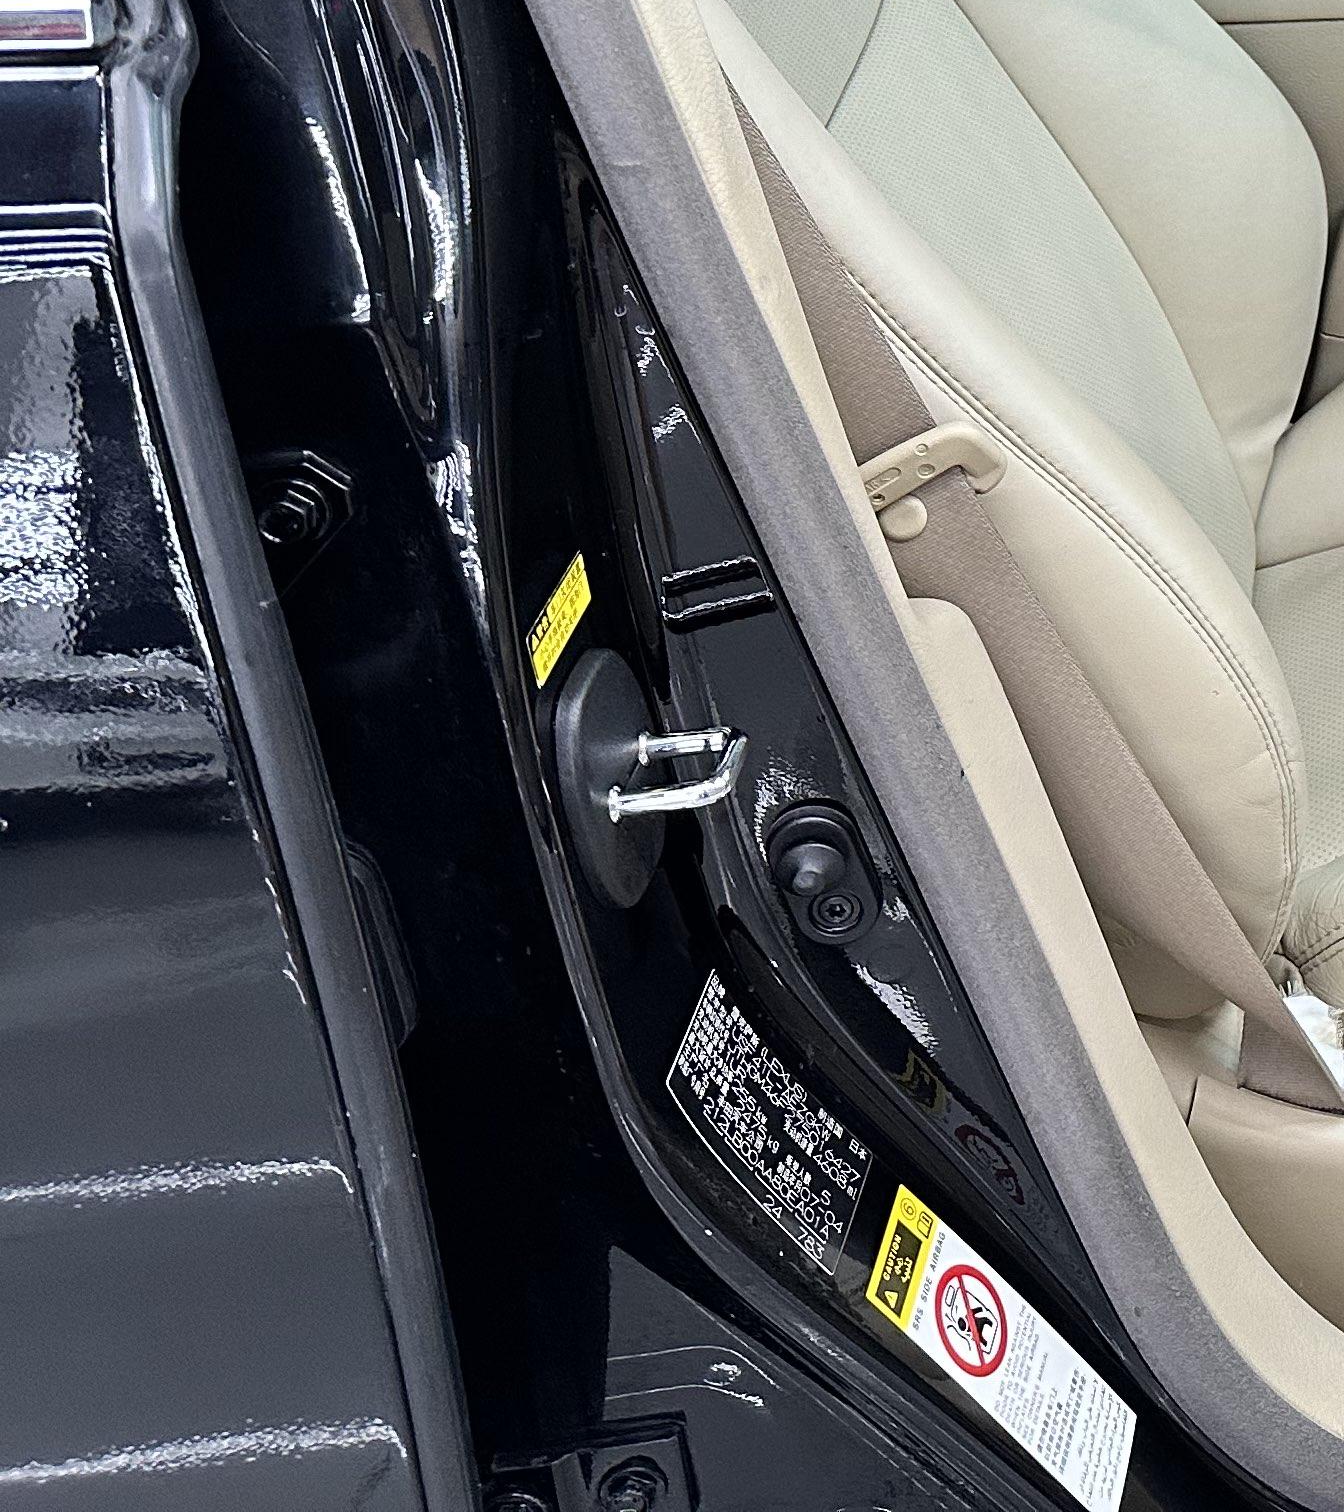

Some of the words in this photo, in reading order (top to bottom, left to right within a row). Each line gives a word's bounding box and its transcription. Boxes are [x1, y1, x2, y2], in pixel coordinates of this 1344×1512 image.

[731, 1079, 756, 1110] 255
[761, 1047, 806, 1105] (LEXUS)
[849, 1139, 866, 1159] 日本
[734, 1100, 766, 1139] 2475
[767, 1135, 779, 1153] kg
[820, 1190, 830, 1204] 5
[813, 1150, 846, 1188] 4608
[763, 1194, 782, 1219] 24
[798, 1226, 825, 1260] 783
[800, 1187, 842, 1232] 07-04
[883, 1235, 900, 1279] CAUTION
[912, 1308, 923, 1330] SRS
[921, 1277, 932, 1302] SIDE
[930, 1232, 945, 1272] AIRBAG
